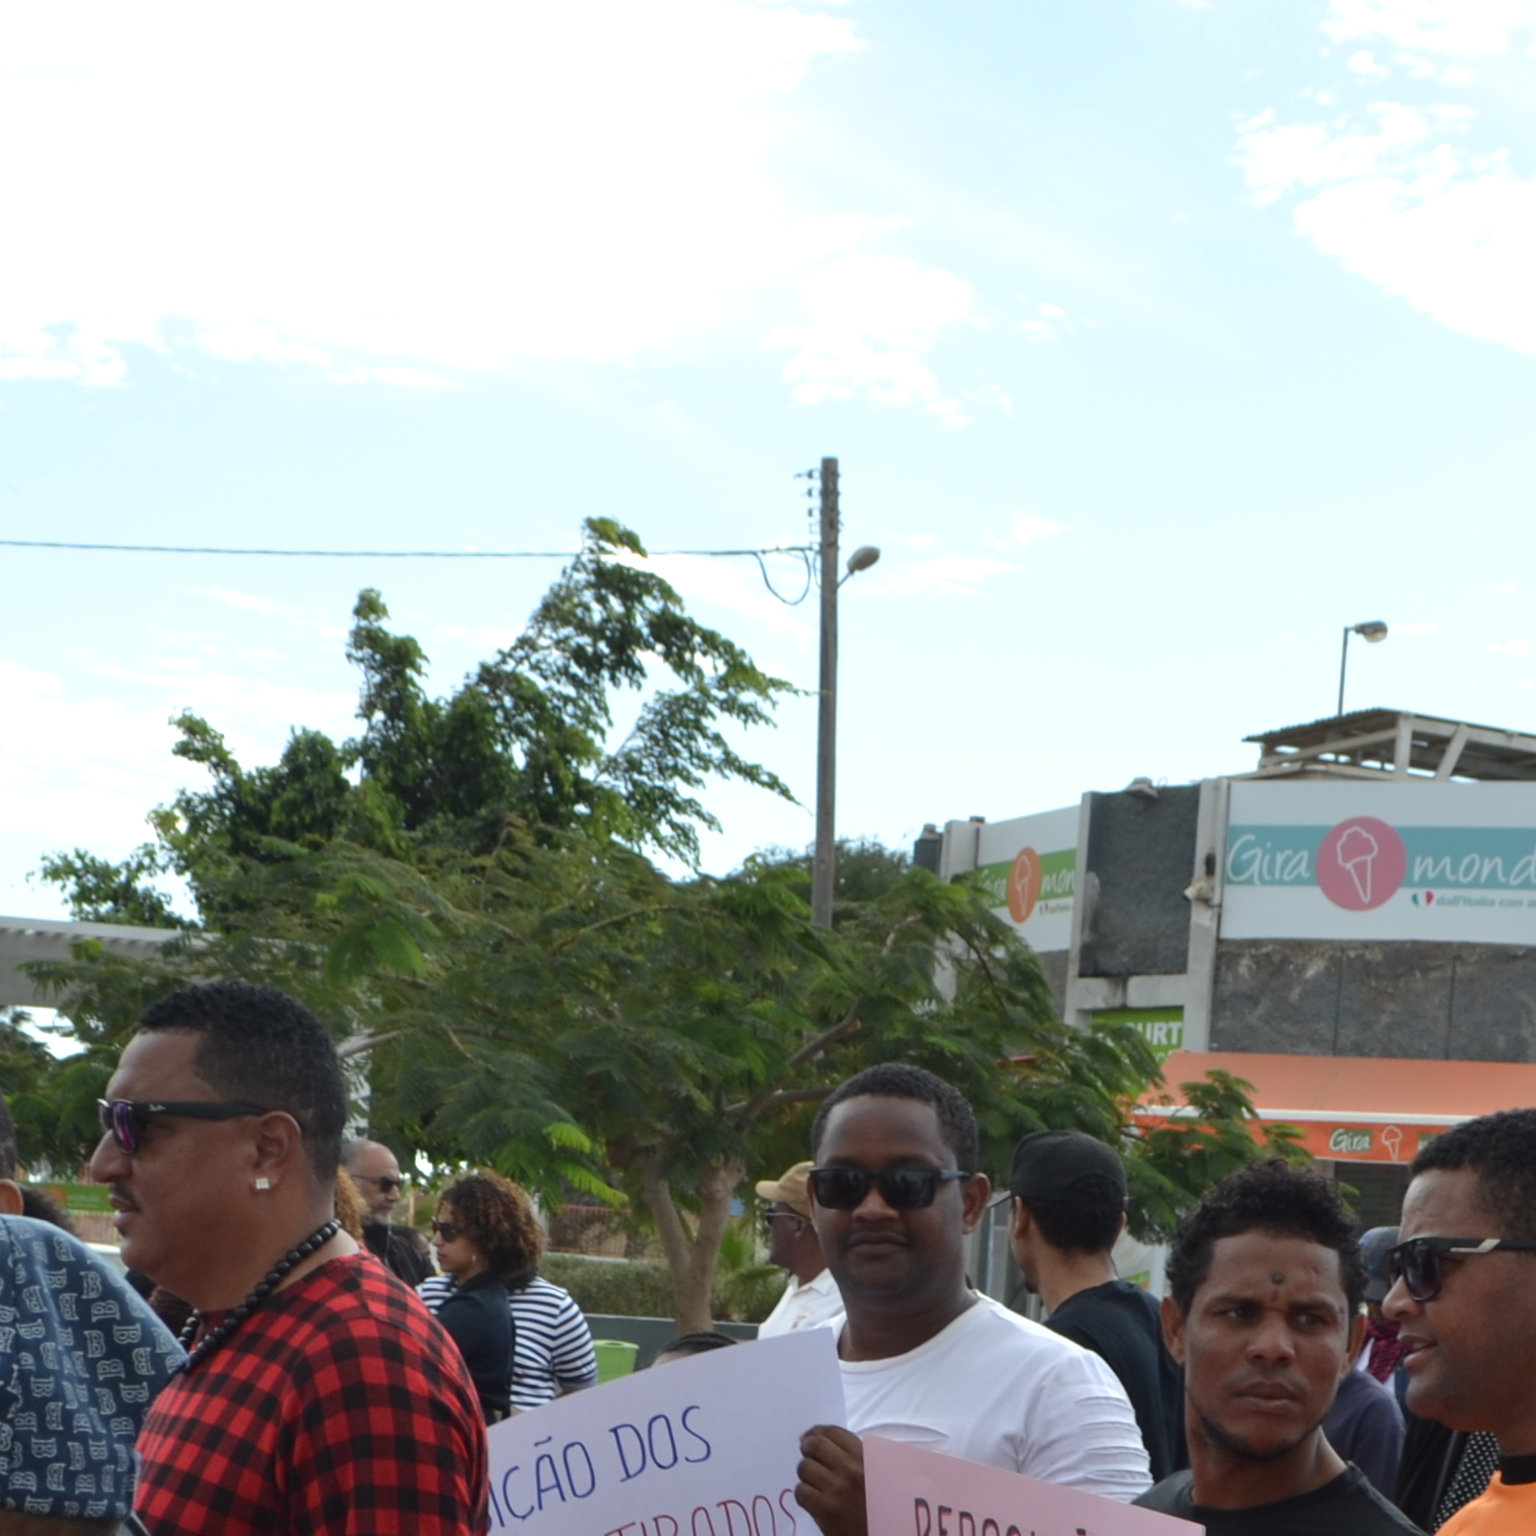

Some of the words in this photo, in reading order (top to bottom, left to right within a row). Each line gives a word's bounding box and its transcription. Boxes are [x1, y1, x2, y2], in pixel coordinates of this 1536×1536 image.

[1226, 834, 1312, 886] Gira
[1330, 1128, 1370, 1153] Gira
[609, 1405, 711, 1482] DOS
